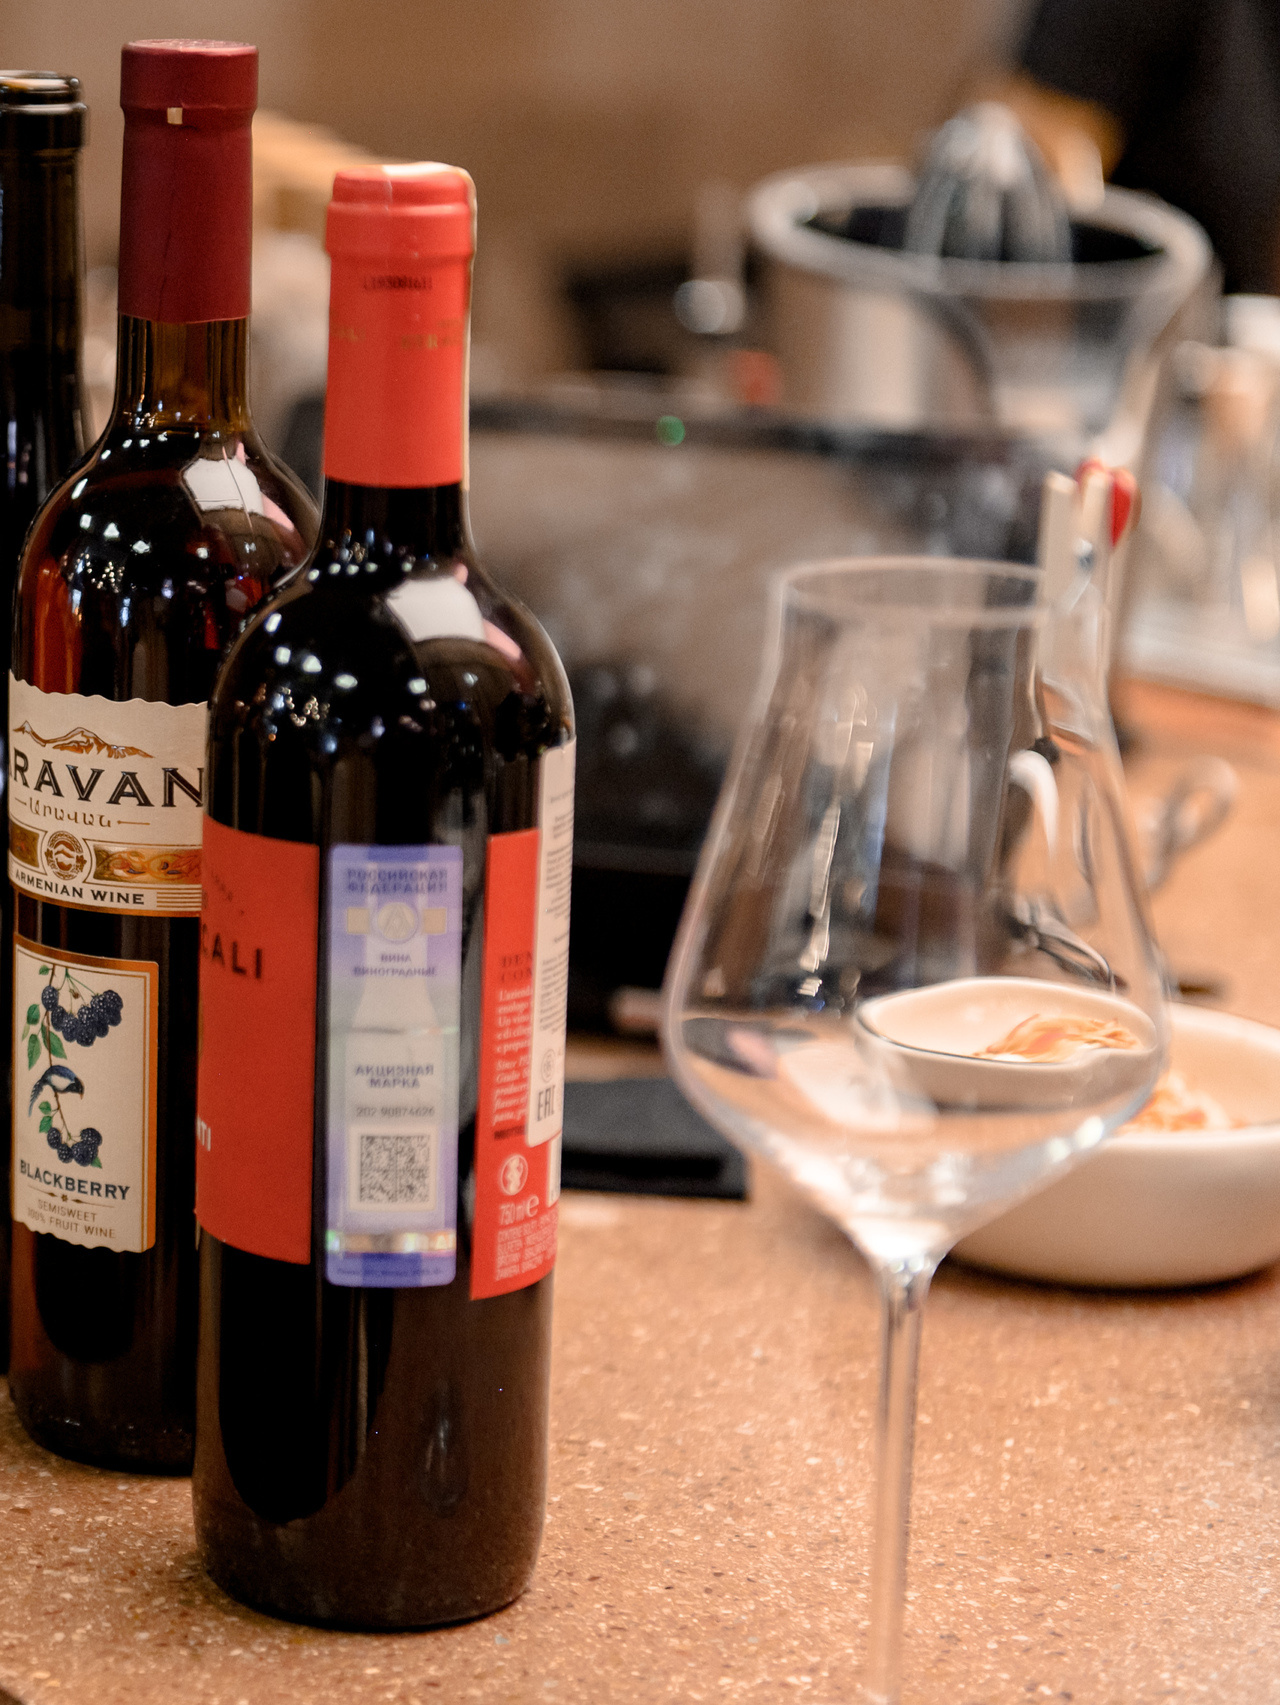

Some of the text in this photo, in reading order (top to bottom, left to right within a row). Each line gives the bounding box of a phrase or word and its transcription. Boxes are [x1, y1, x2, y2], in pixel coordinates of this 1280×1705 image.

[10, 748, 203, 808] RAVAN
[16, 869, 144, 906] ARMENIAN WINE
[355, 1064, 434, 1078] АКЦИЗНАЯ
[369, 1077, 420, 1089] МАРКА
[20, 1159, 130, 1200] BLACKBERRY
[38, 1199, 97, 1223] SEMISWEET
[49, 1216, 79, 1233] FRUIT
[83, 1226, 116, 1239] WINE
